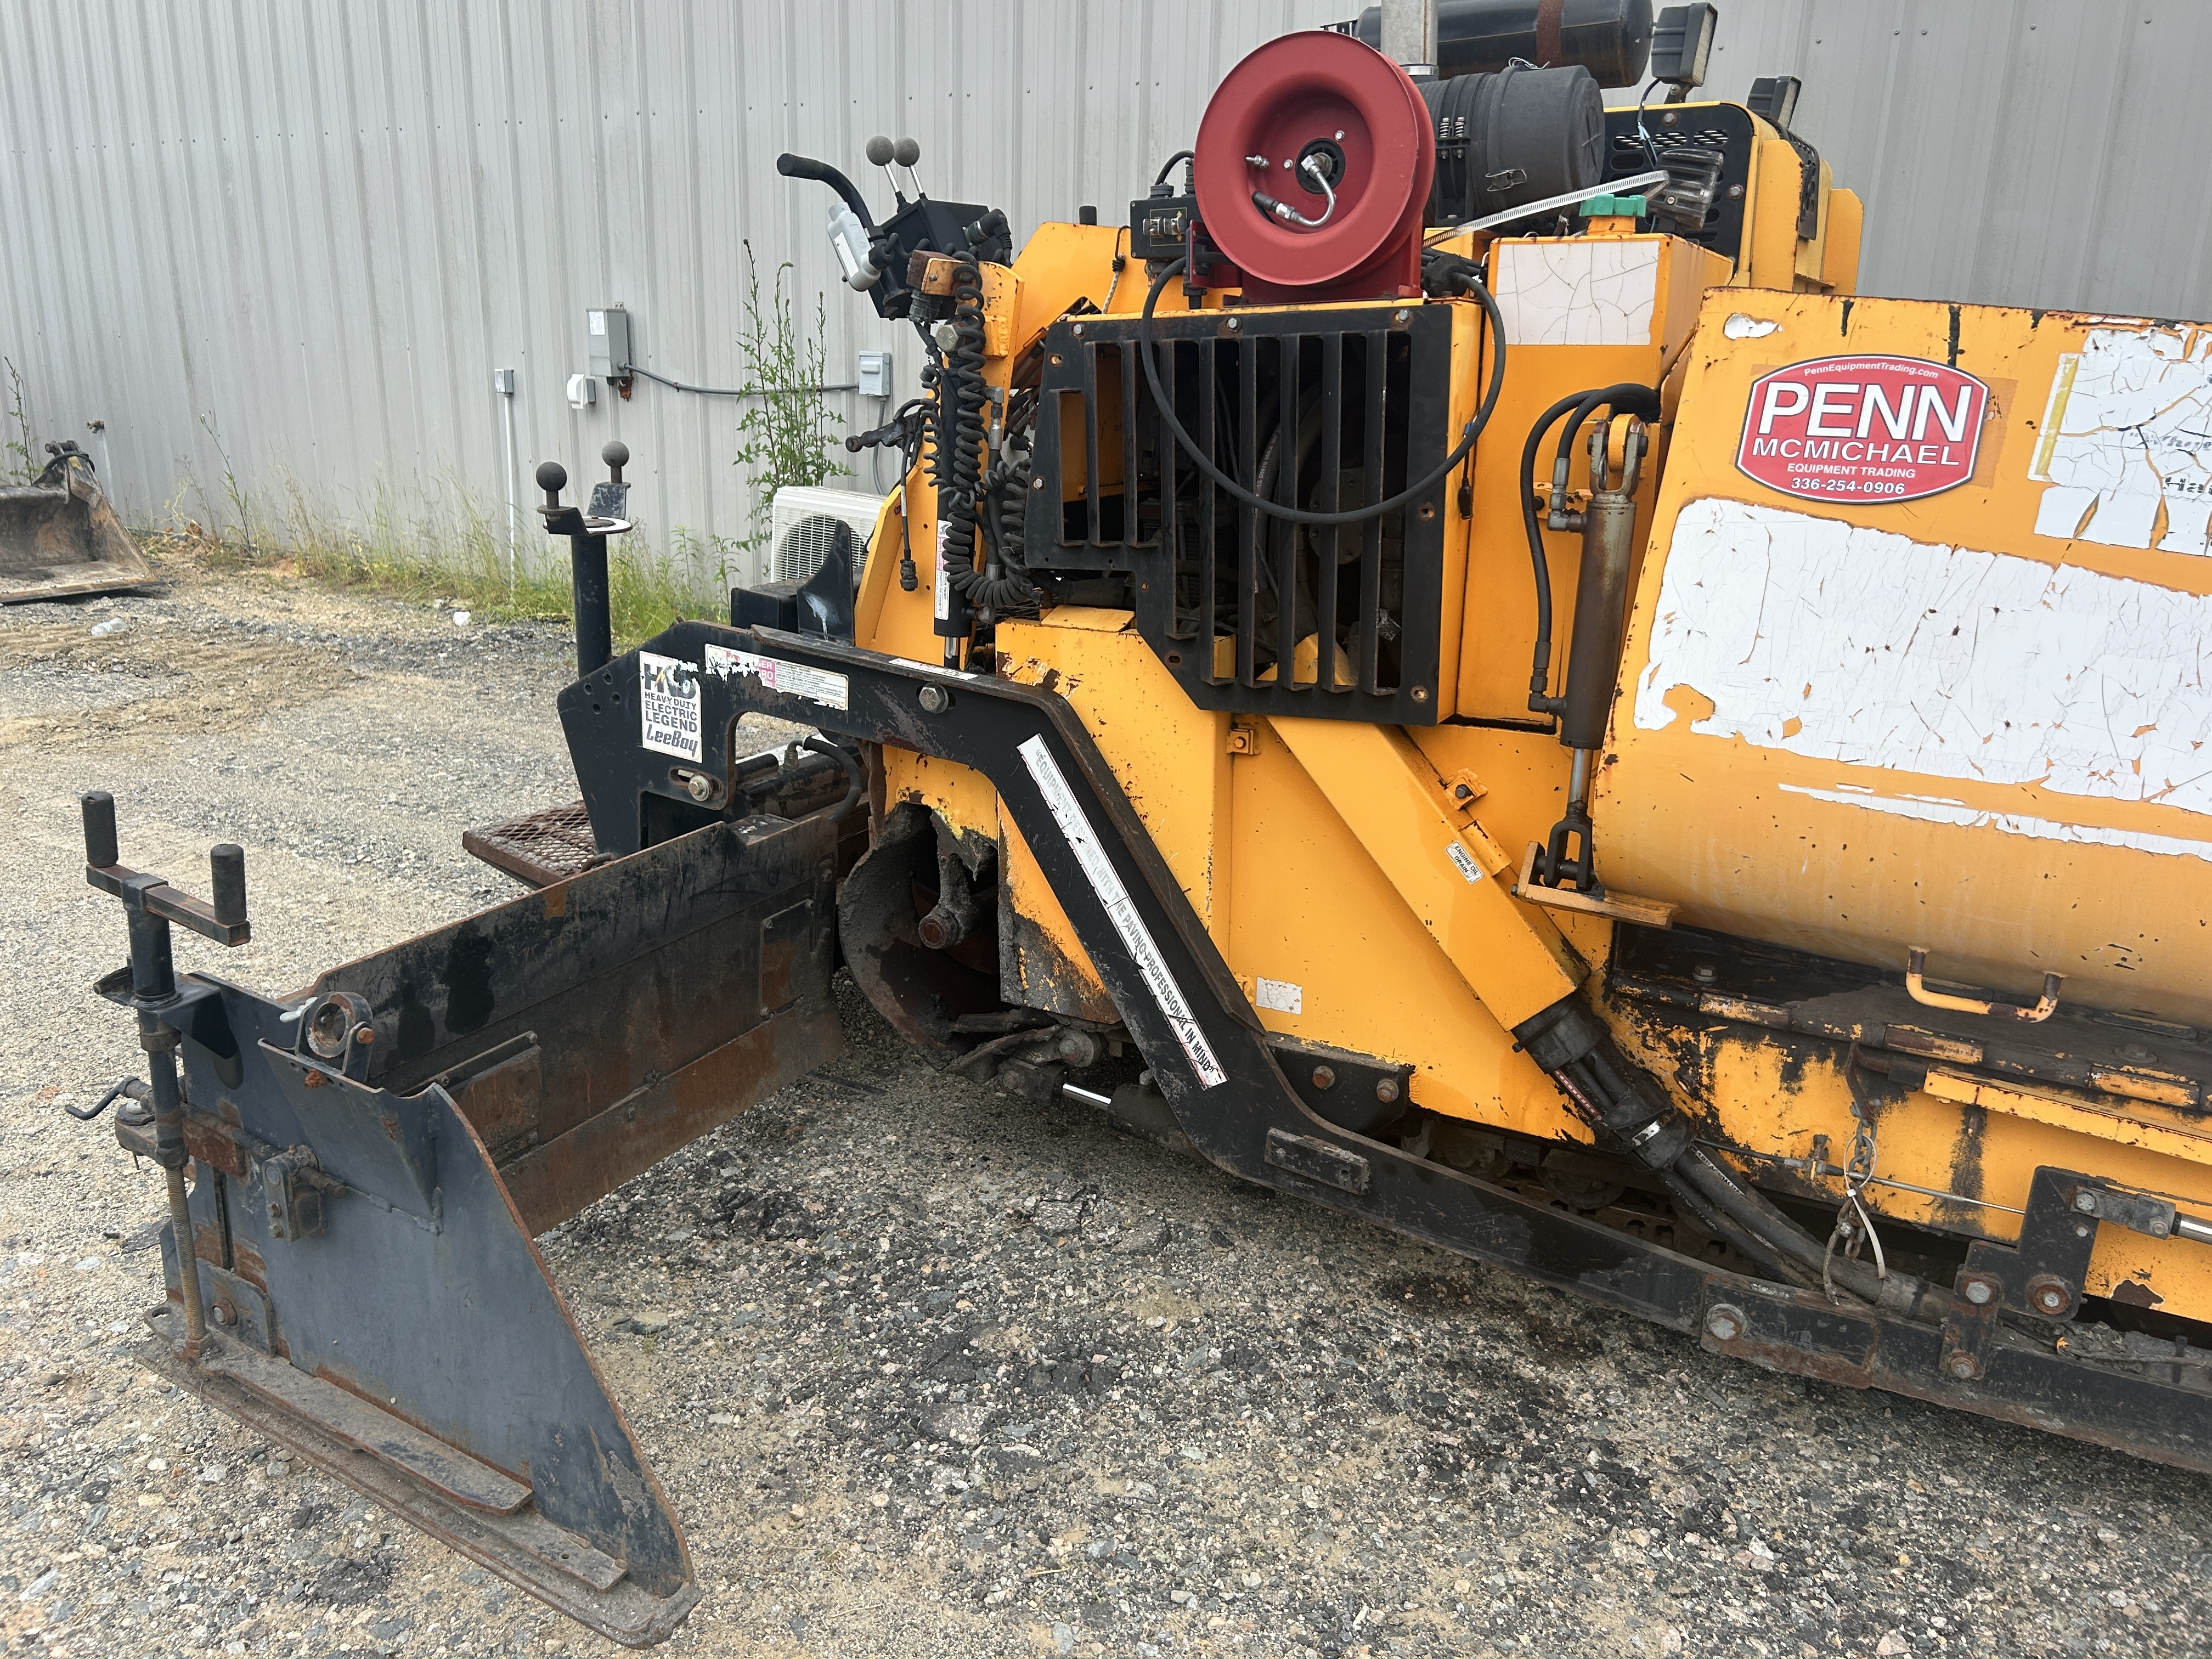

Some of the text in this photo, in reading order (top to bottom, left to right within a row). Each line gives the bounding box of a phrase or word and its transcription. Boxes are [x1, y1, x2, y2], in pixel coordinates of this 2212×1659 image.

[1804, 362, 1939, 380] PennEquipmentTrading.com
[1757, 381, 1973, 442] PENN
[1752, 437, 1960, 466] MCMICHAEL
[1787, 462, 1916, 479] EQUIPMENT TRADING
[1790, 477, 1905, 495] 336-254-0906
[645, 691, 696, 710] HEAVY DUTY
[645, 700, 697, 721] ELECTRIC
[645, 710, 698, 733] LEGEND
[646, 724, 698, 758] LeeBoy
[1454, 845, 1479, 876] ENGINE OIL
[1454, 855, 1469, 873] DRAIN
[1096, 864, 1115, 896] WITH
[1111, 891, 1127, 917] THE
[1122, 913, 1147, 955] PAVING
[1144, 953, 1186, 1032] PROFESSIONAL
[1184, 1027, 1197, 1045] IN
